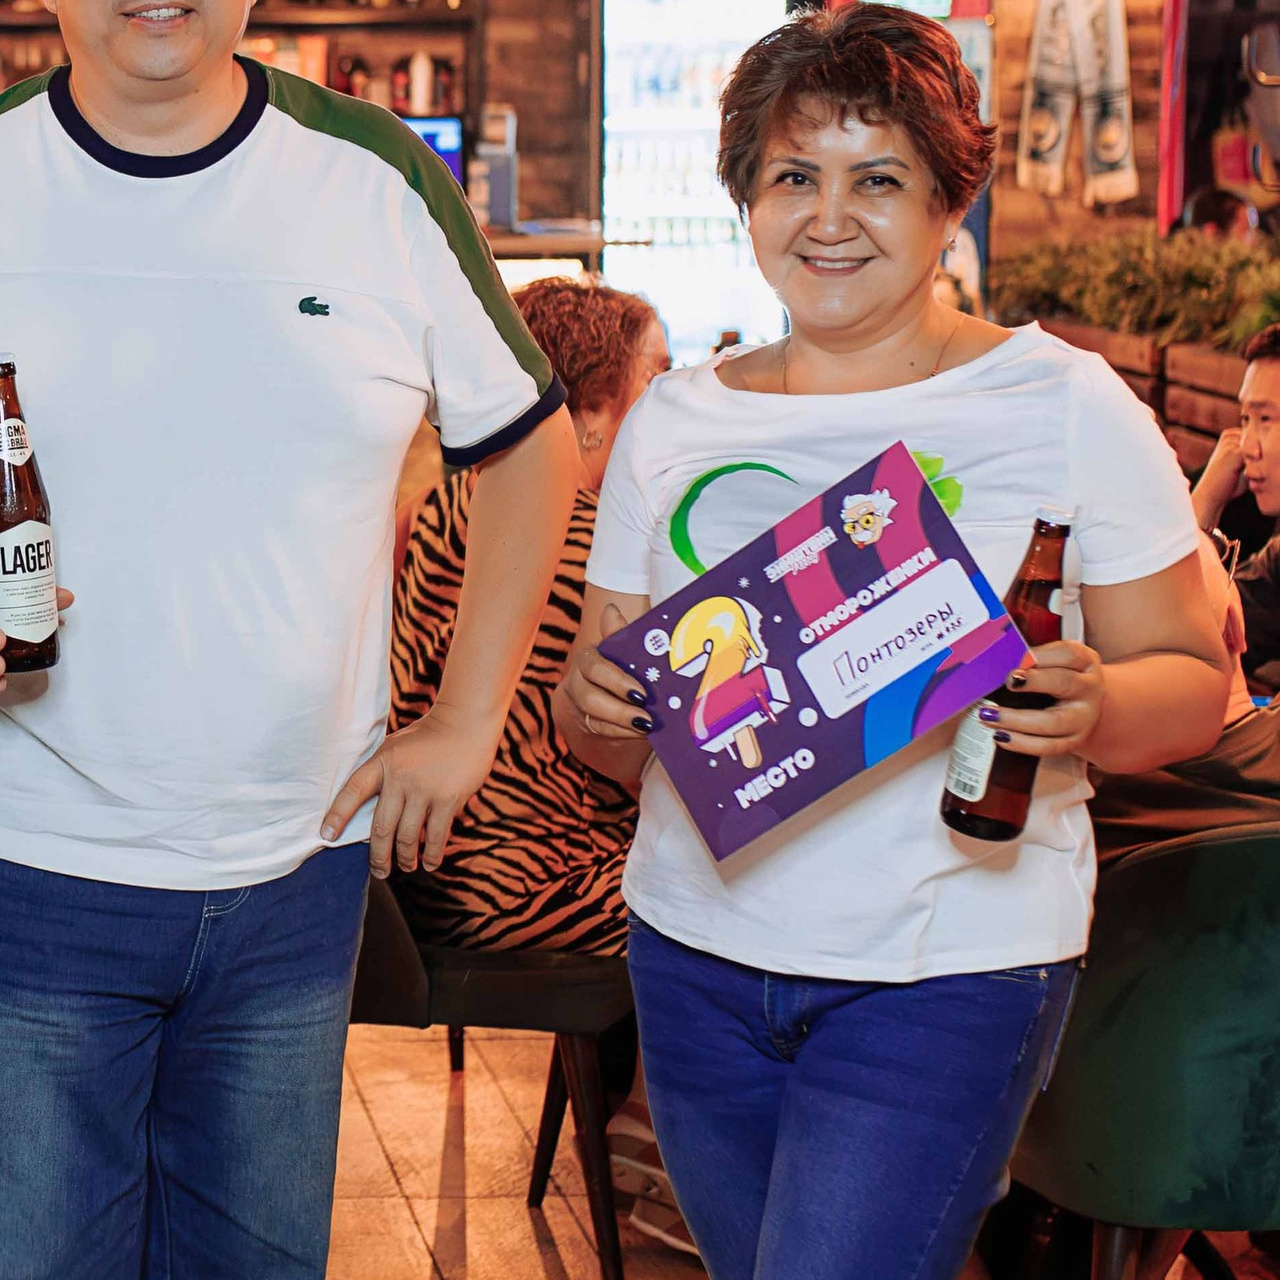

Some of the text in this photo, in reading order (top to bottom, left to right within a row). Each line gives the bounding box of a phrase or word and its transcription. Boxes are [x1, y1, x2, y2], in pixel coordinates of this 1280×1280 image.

[0, 539, 53, 576] LAGER
[799, 546, 938, 644] ОТМОРОЖЕНКИ
[733, 747, 817, 810] МЕСТО
